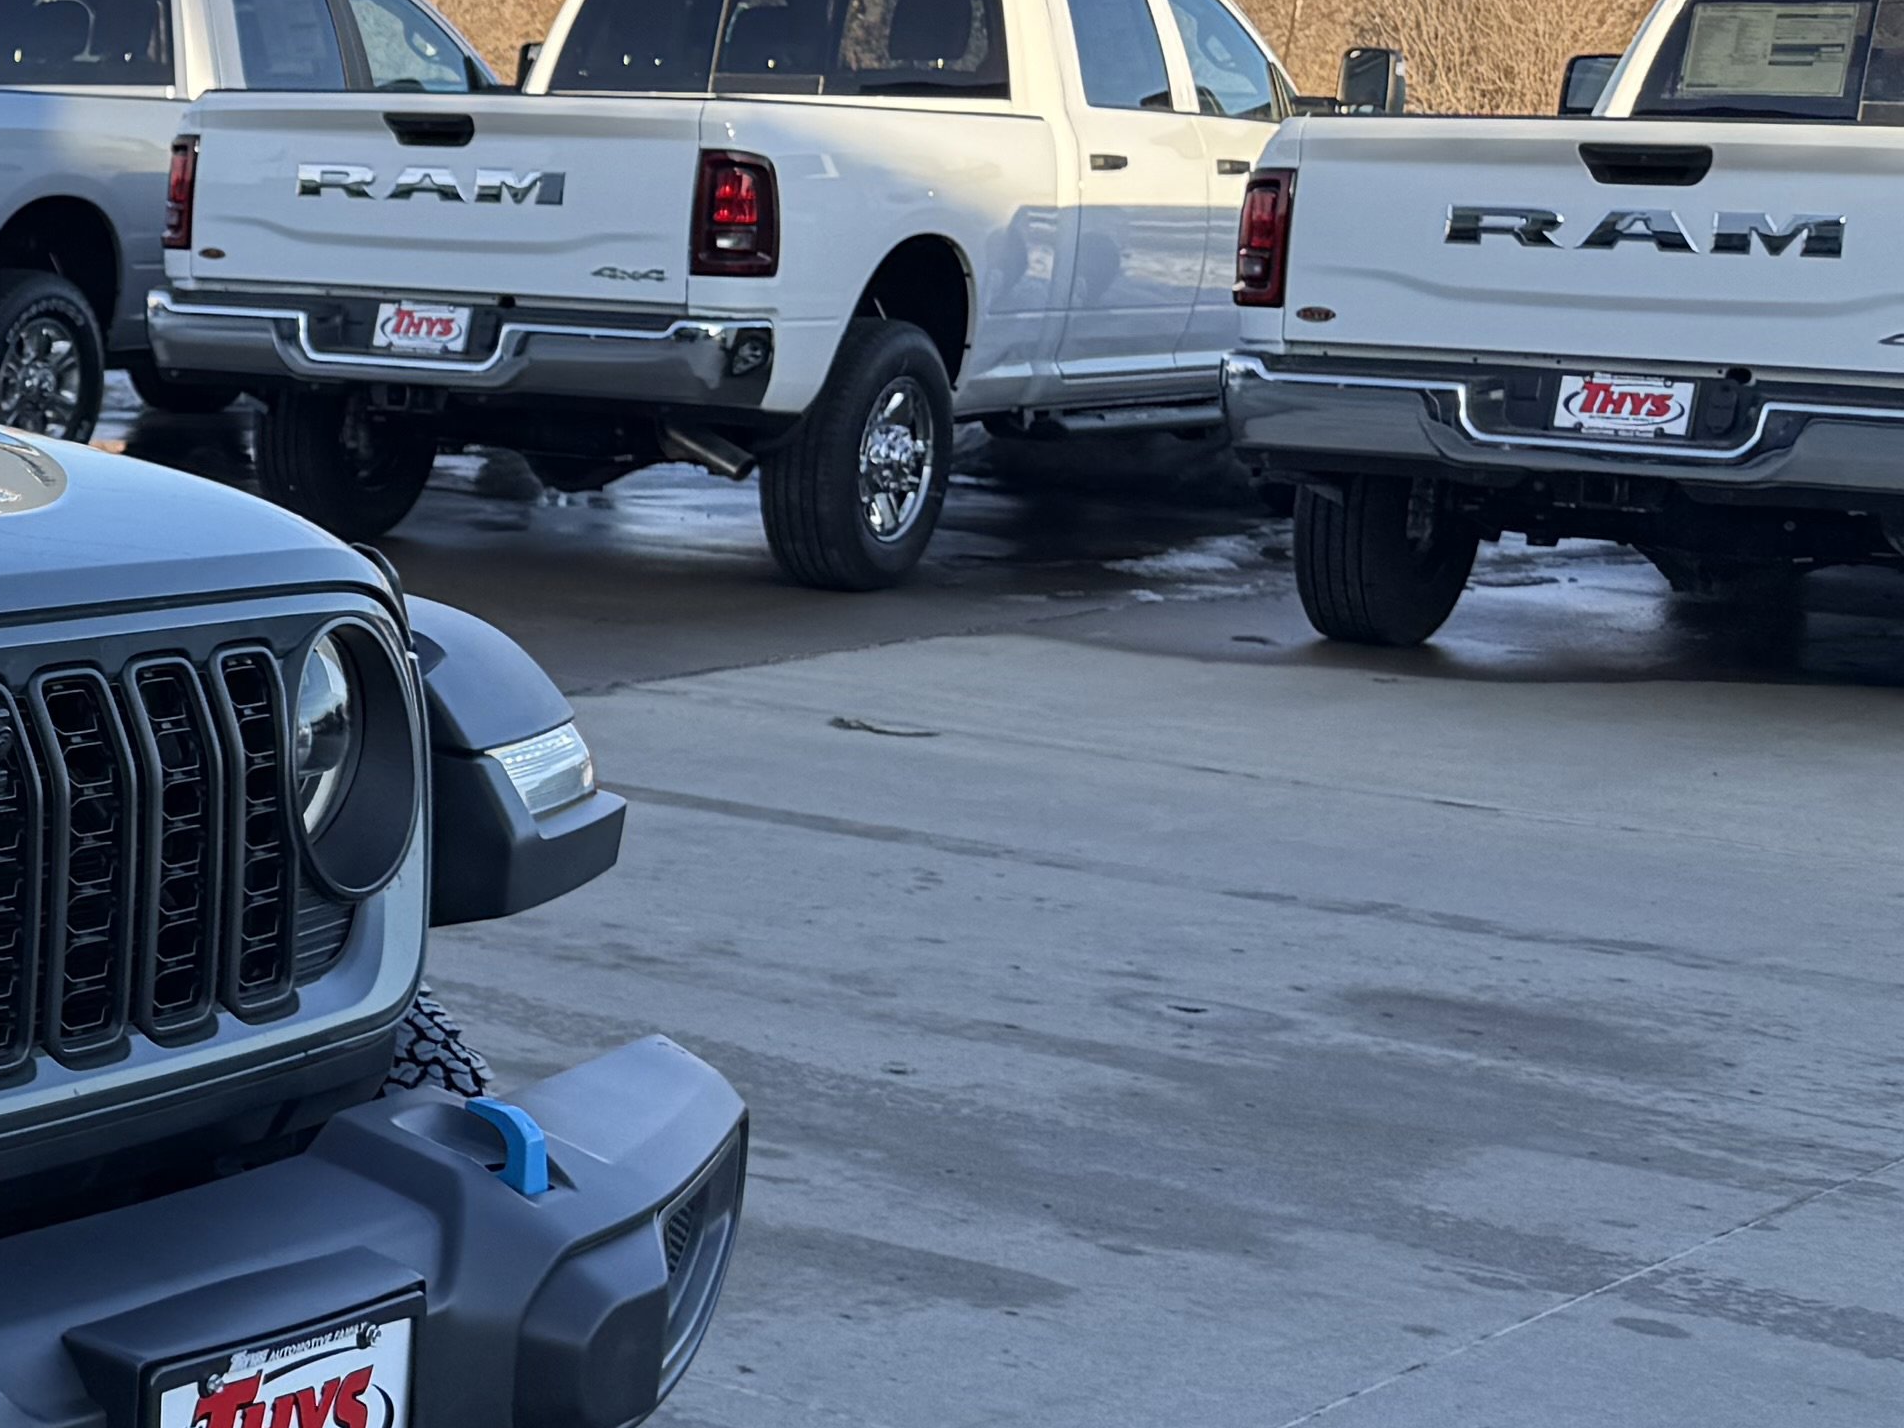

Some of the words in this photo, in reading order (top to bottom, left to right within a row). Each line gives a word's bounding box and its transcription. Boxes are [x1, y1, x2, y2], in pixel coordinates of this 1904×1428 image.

[297, 163, 567, 206] RAM
[1443, 204, 1848, 258] RAM
[1579, 381, 1674, 417] THYS
